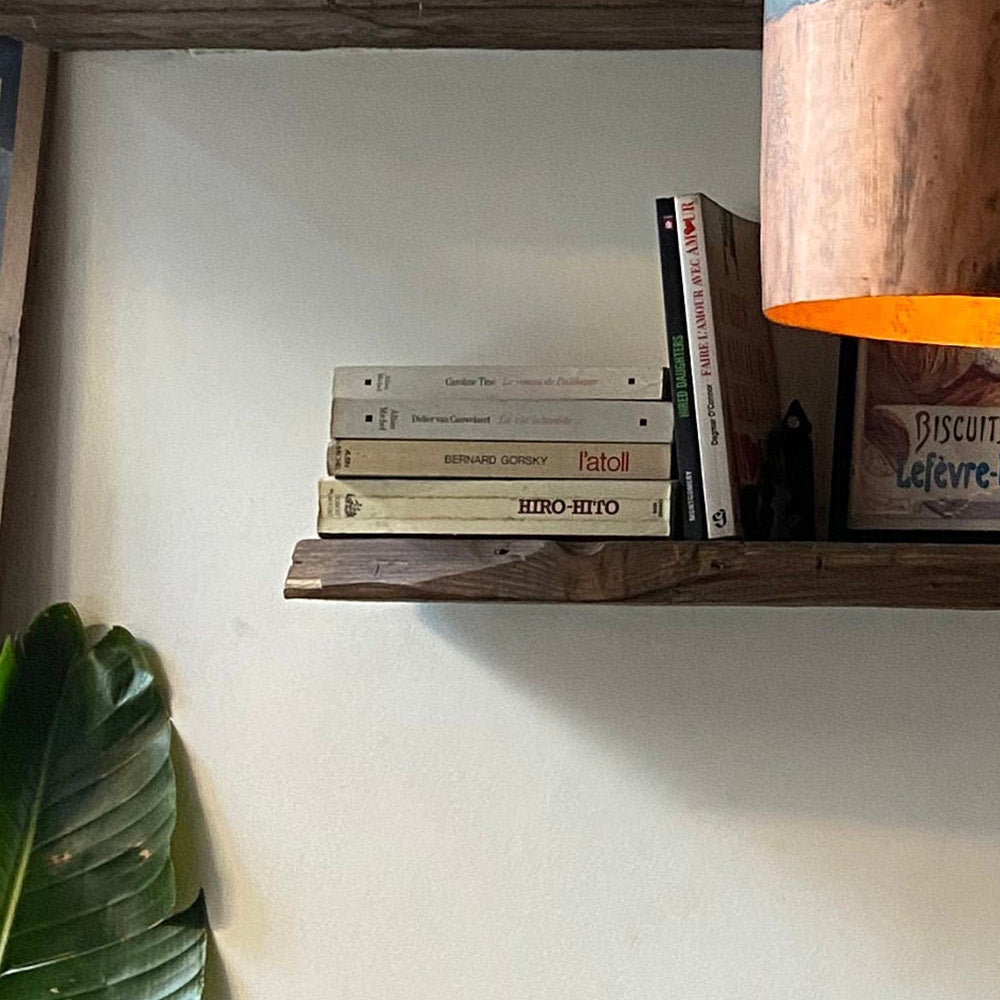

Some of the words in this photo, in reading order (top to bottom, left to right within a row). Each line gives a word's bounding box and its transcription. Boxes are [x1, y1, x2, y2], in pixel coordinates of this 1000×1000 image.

[690, 258, 705, 287] AVEC
[693, 289, 709, 344] L'AMOUR
[671, 333, 688, 389] DAUGHTERS
[698, 345, 712, 377] FAIRE
[706, 384, 717, 418] O'Connor
[411, 414, 435, 423] Didier
[709, 418, 721, 446] Dagmar
[444, 453, 497, 466] BERNARD
[500, 454, 549, 466] GORSKY
[578, 450, 630, 473] l'atoll
[517, 498, 621, 516] HIRO-HITO
[686, 470, 696, 523] MONTGOMERY
